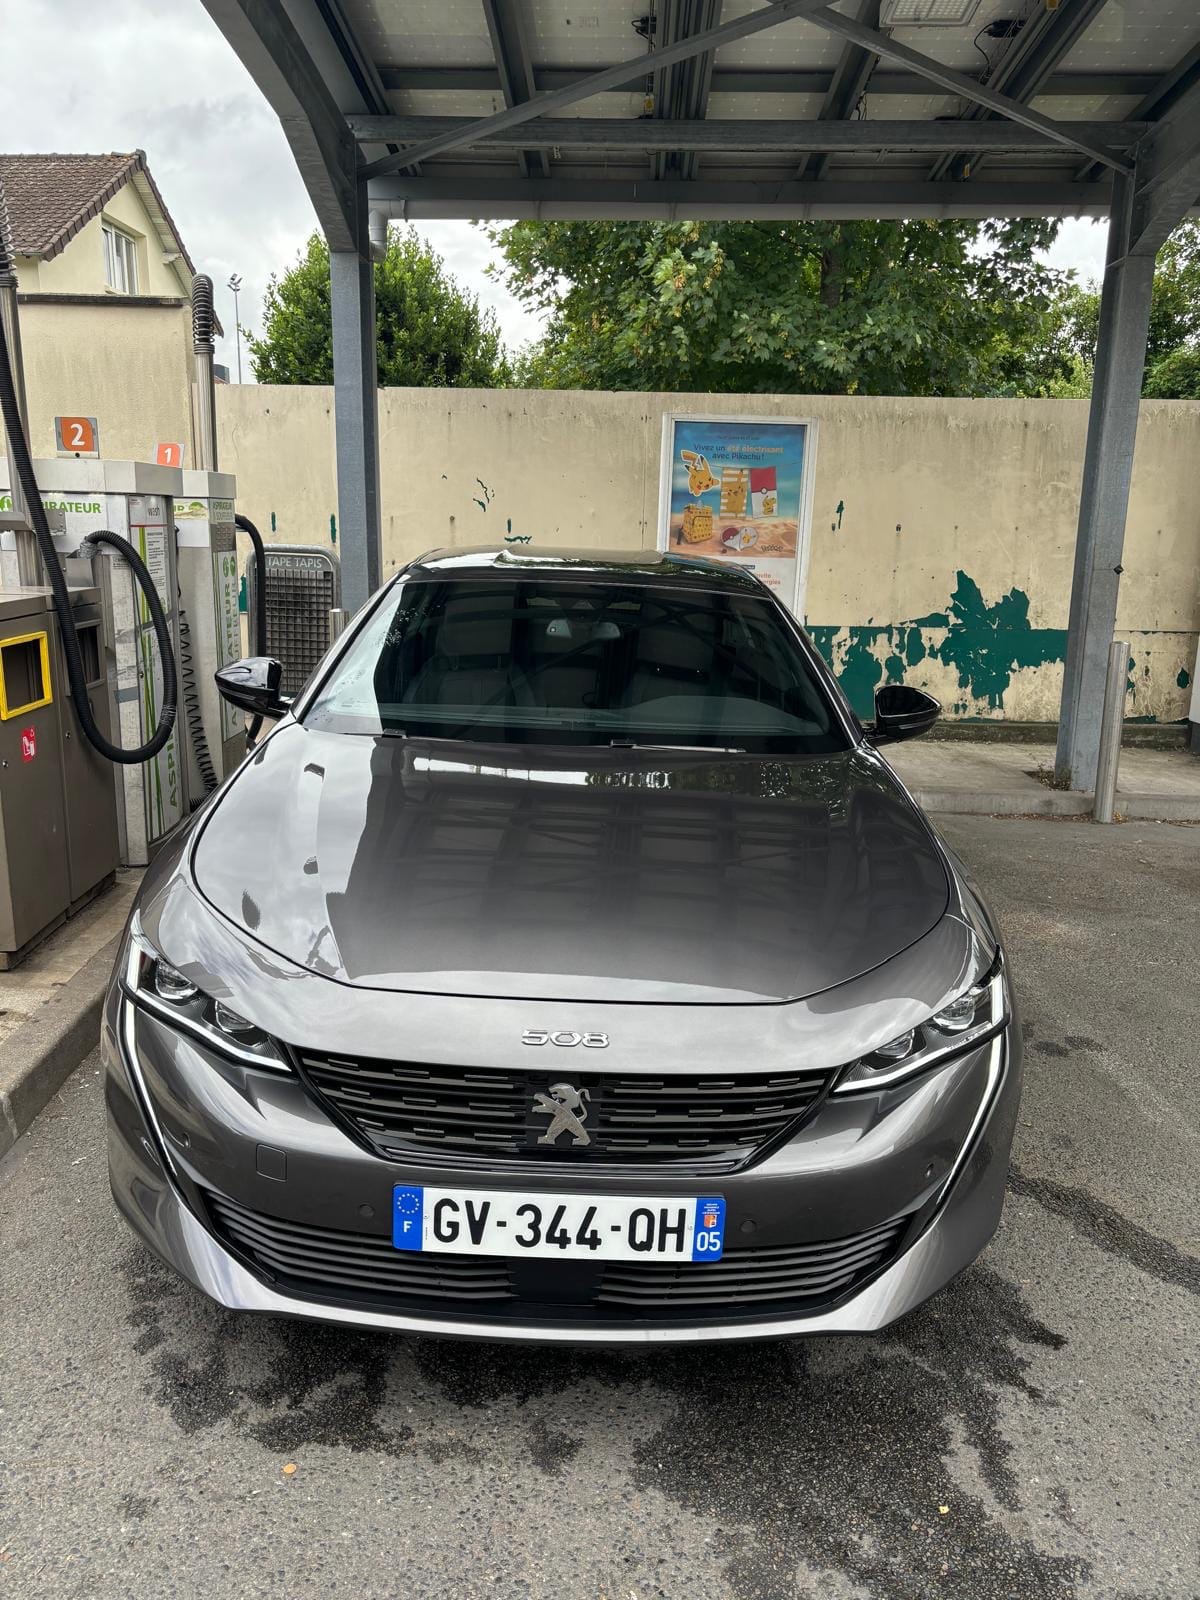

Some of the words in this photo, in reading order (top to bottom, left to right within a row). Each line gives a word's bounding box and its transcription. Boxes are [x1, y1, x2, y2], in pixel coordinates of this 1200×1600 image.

[70, 423, 85, 446] 2
[164, 447, 172, 464] 1
[694, 443, 714, 452] Vivez
[42, 501, 102, 514] IRATEUR
[267, 556, 292, 567] TAPE
[294, 557, 322, 569] TAPIS
[521, 1029, 610, 1048] 508
[403, 1220, 413, 1233] F
[433, 1197, 687, 1253] GV-344-QH
[696, 1231, 721, 1253] 05
